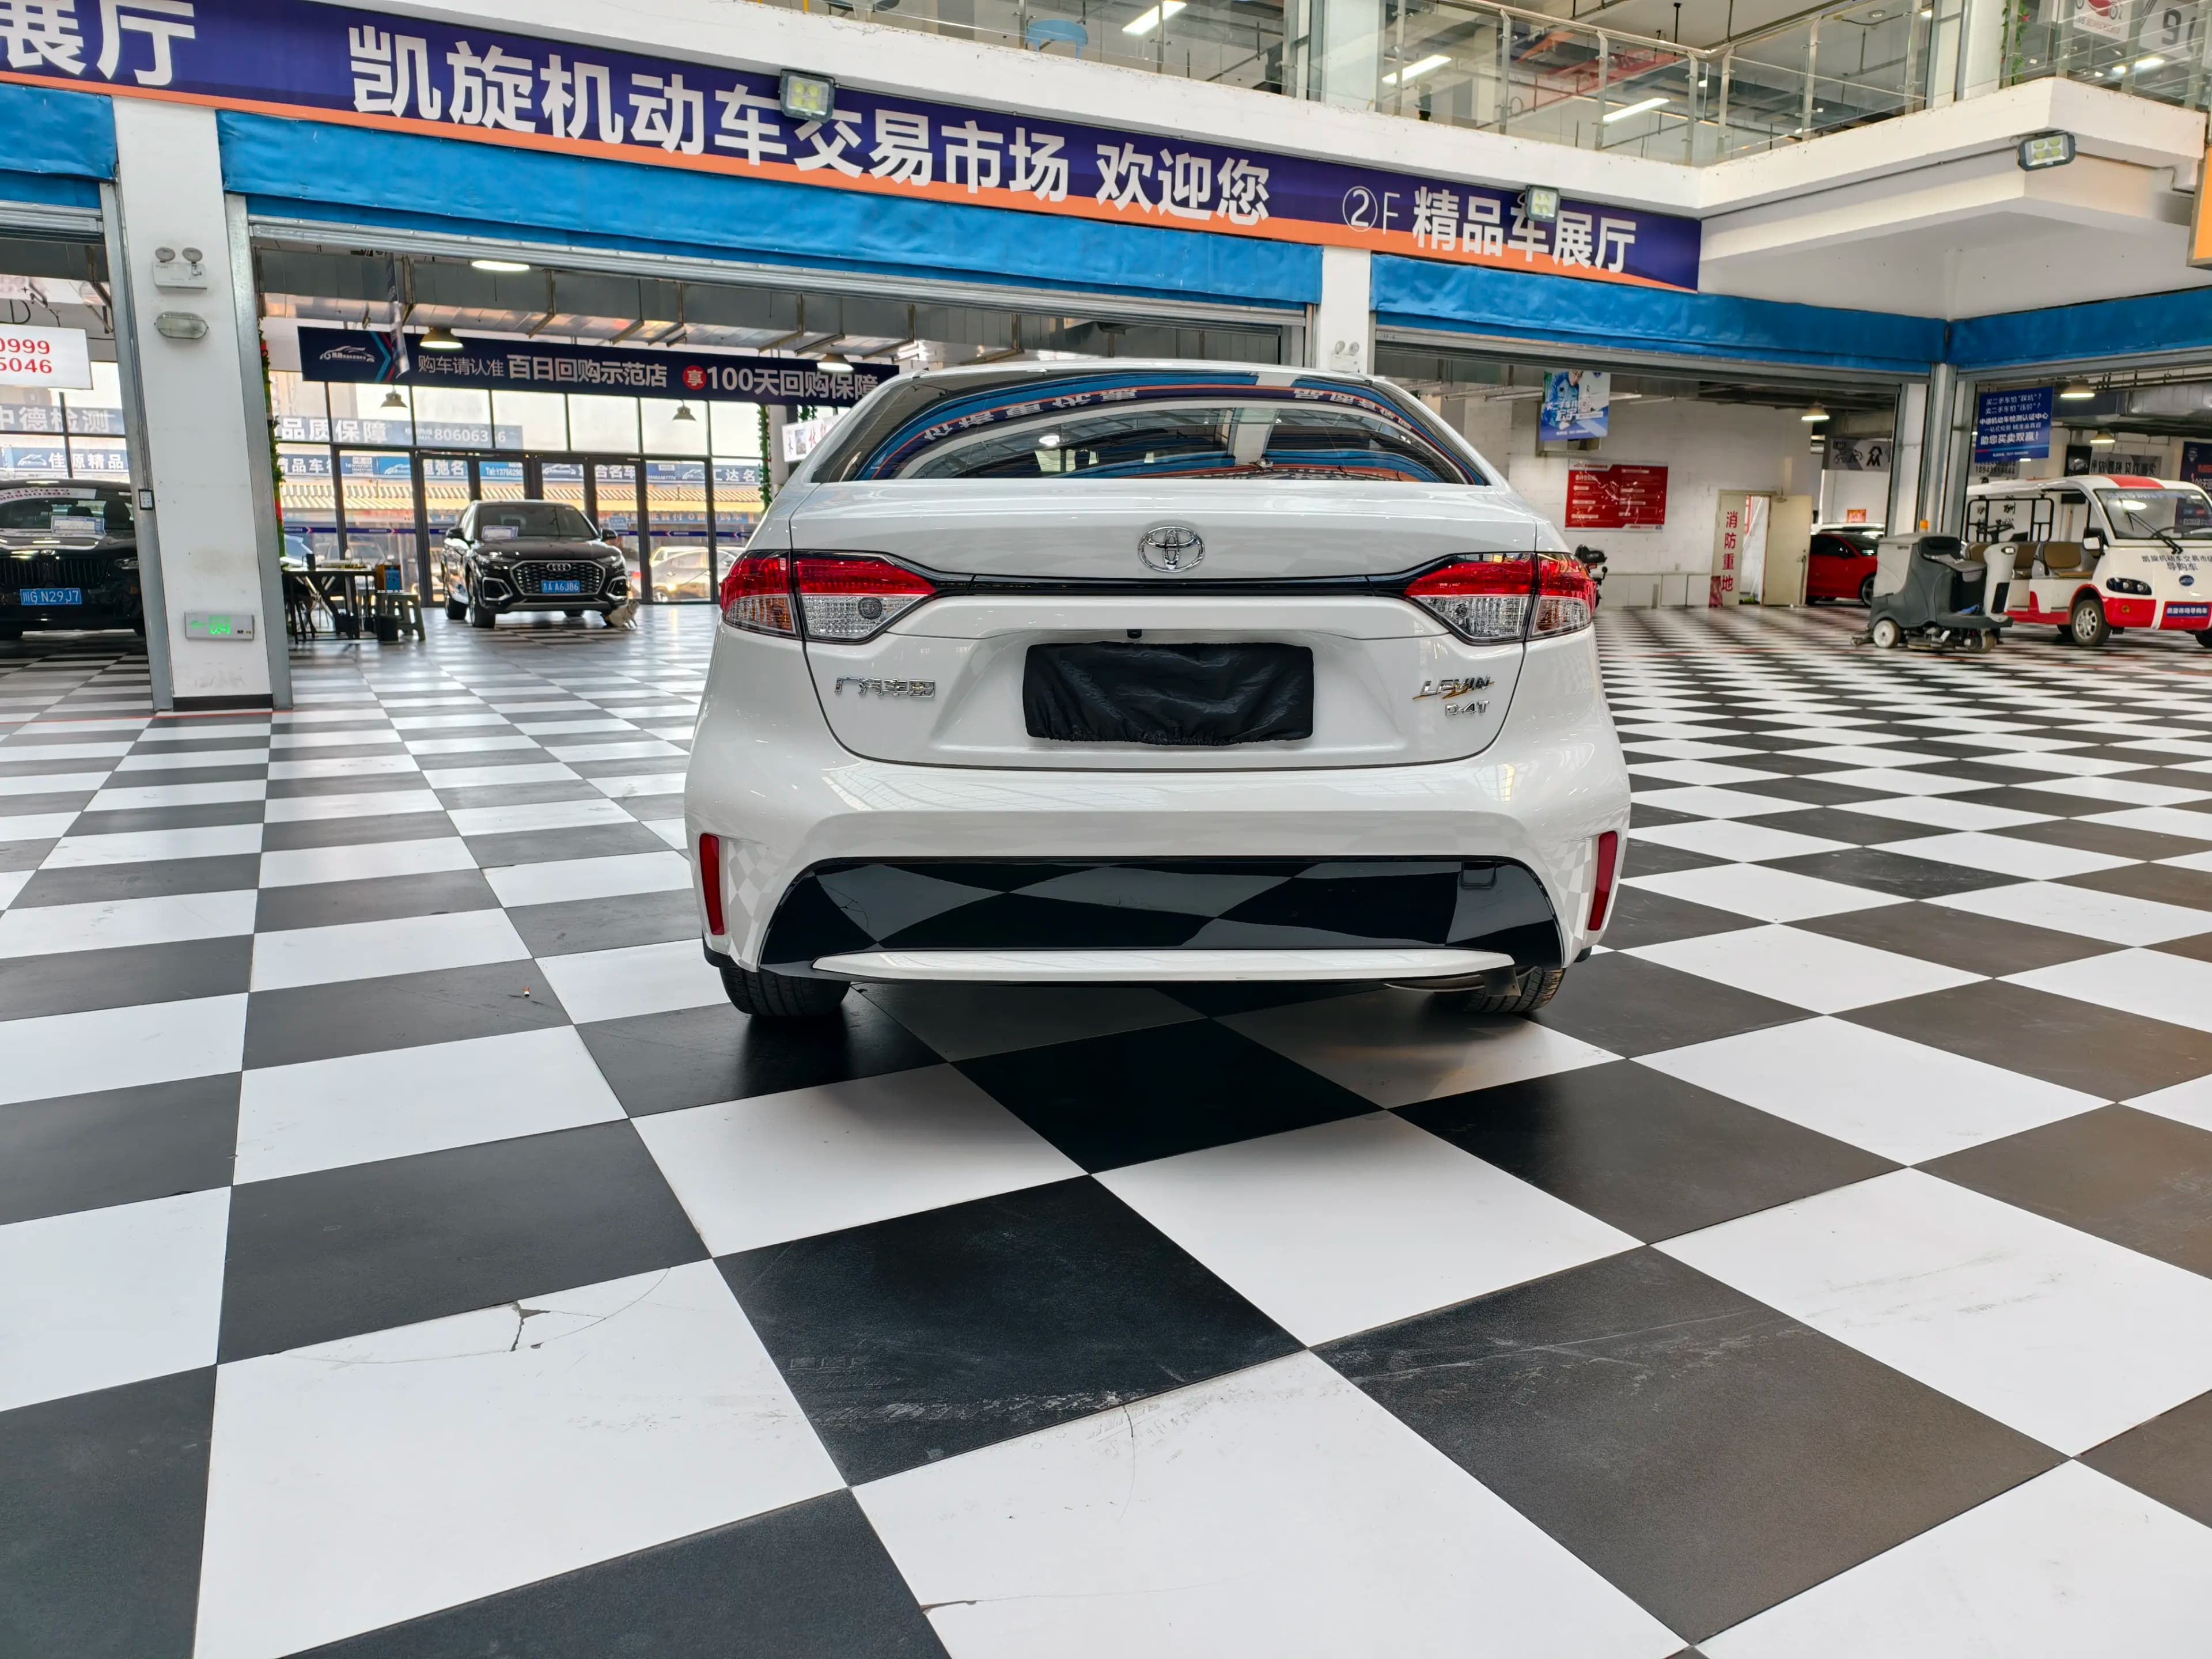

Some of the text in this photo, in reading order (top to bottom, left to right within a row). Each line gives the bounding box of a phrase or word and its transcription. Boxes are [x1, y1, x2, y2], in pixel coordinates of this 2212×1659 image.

[349, 25, 1270, 226] 凯旋机动车交易市场 欢迎您
[1412, 185, 1637, 273] 精品车展厅
[418, 354, 504, 378] 购车请认准
[507, 354, 668, 388] 百日回购示范店
[707, 366, 878, 400] 100天回购保障
[282, 418, 388, 443] 品质保障
[434, 428, 506, 443] 8060636
[1721, 510, 1738, 592] 消防重地
[834, 676, 935, 698] 广汽丰田
[1420, 674, 1491, 695] LEVIN
